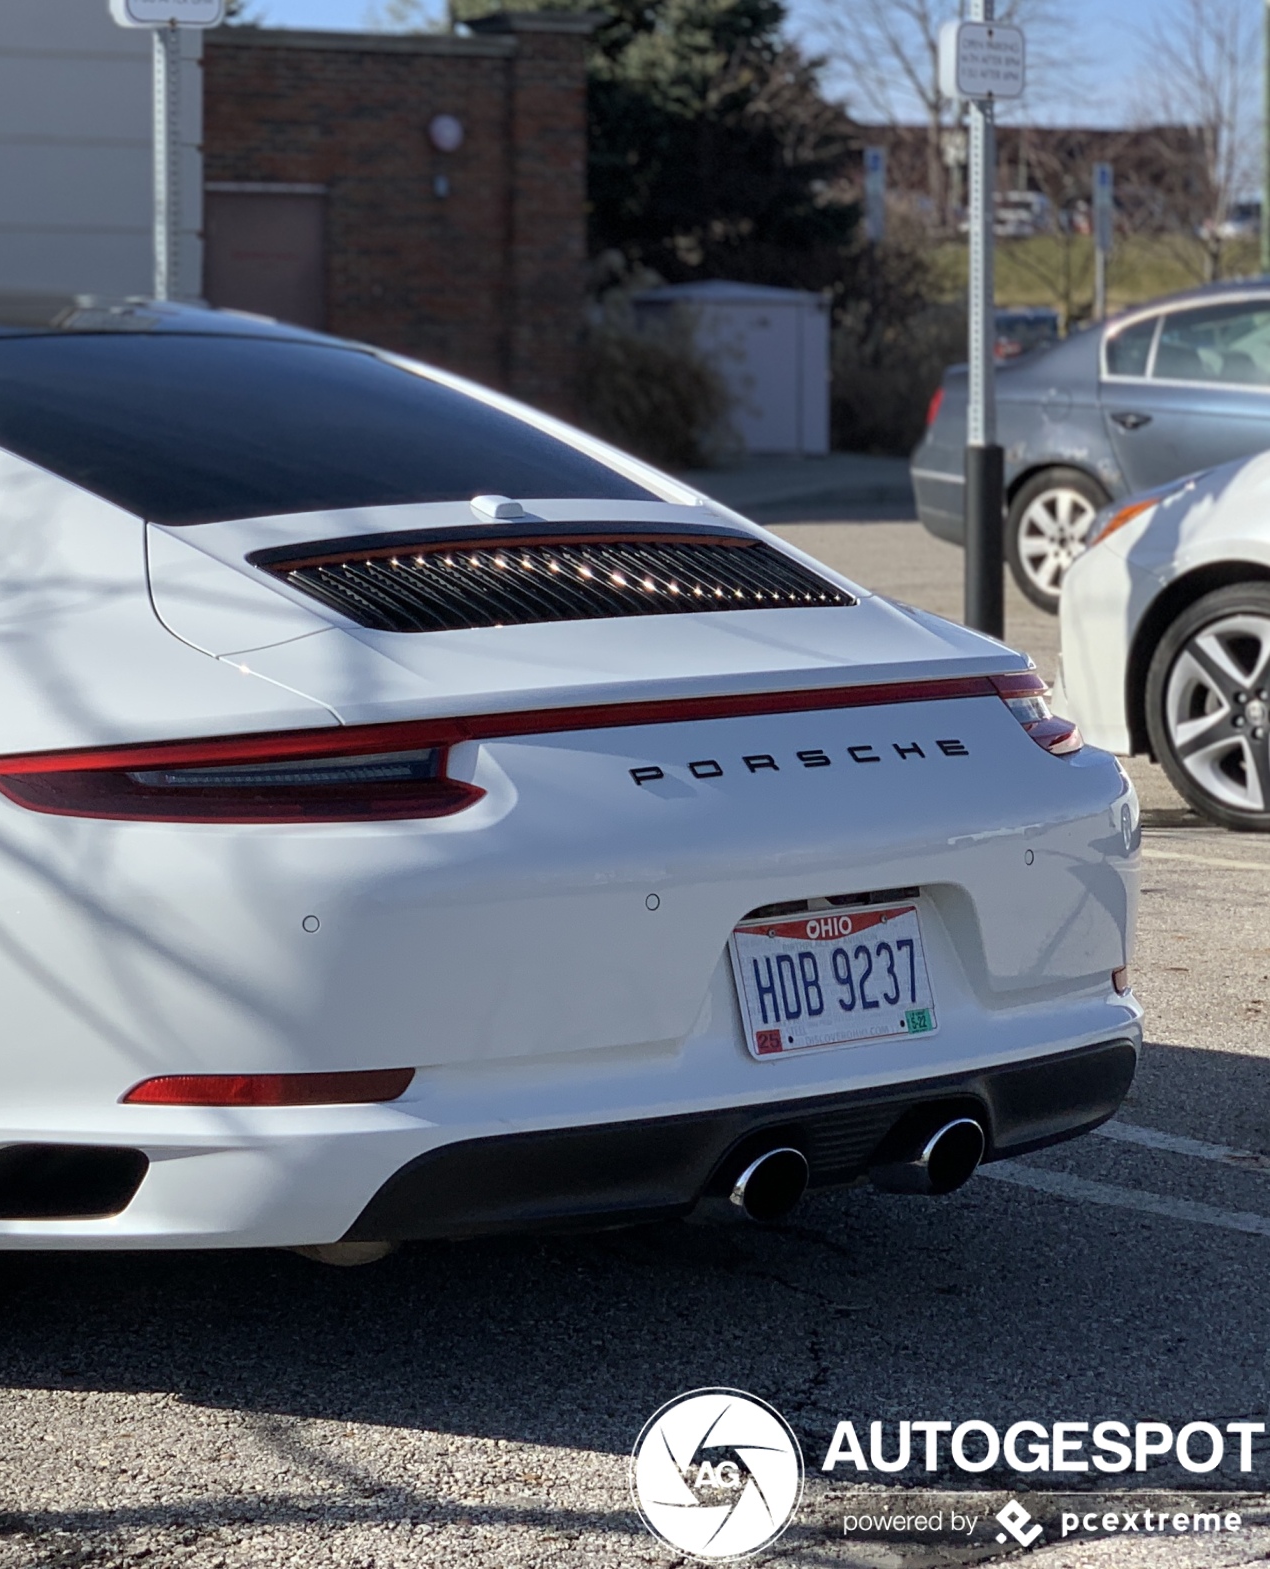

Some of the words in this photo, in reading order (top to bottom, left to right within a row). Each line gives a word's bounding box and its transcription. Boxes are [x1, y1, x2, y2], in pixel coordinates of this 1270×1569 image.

[629, 739, 969, 786] PORSCHE
[806, 916, 852, 939] OHIO
[753, 952, 824, 1023] HDB
[832, 939, 916, 1011] 9237
[758, 1034, 781, 1049] 25
